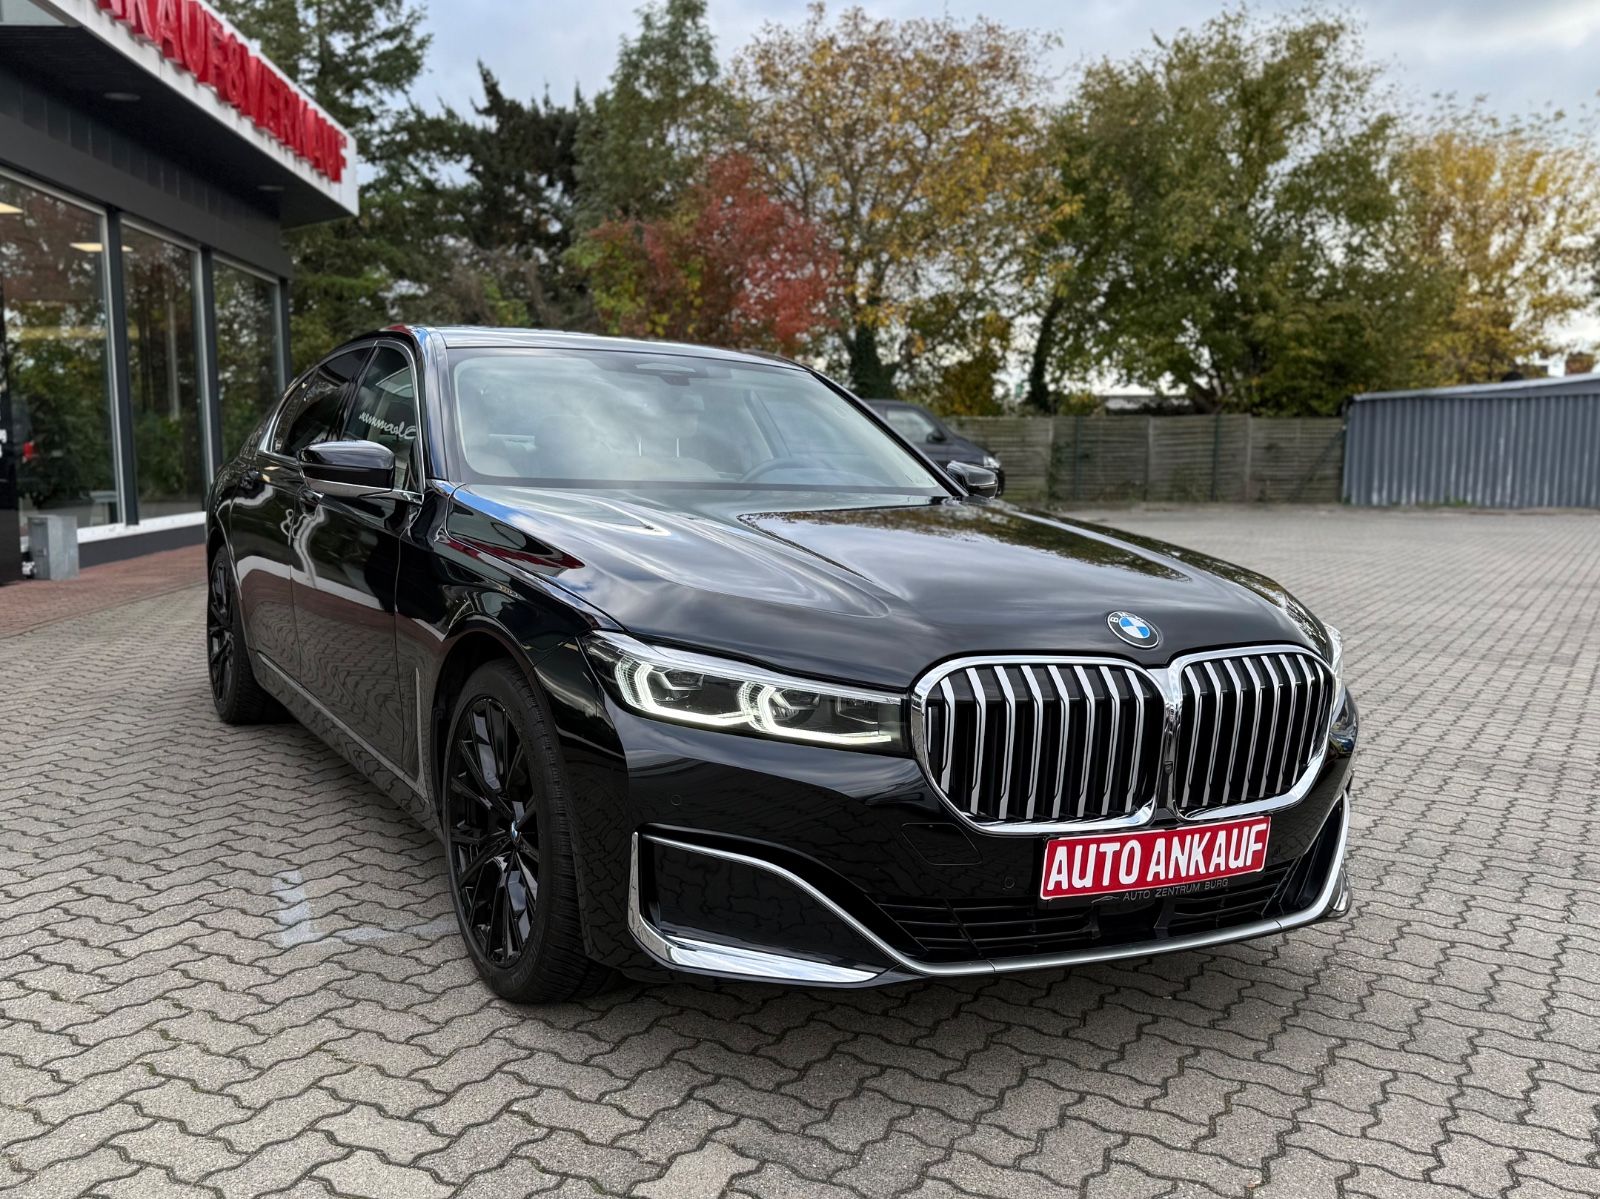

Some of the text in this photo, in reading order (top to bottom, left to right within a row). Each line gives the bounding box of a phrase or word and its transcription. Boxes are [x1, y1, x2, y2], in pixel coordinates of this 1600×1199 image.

[1046, 823, 1267, 891] AUTO ANKAUF
[1122, 878, 1229, 901] AUTO ZENTRUM BURG
